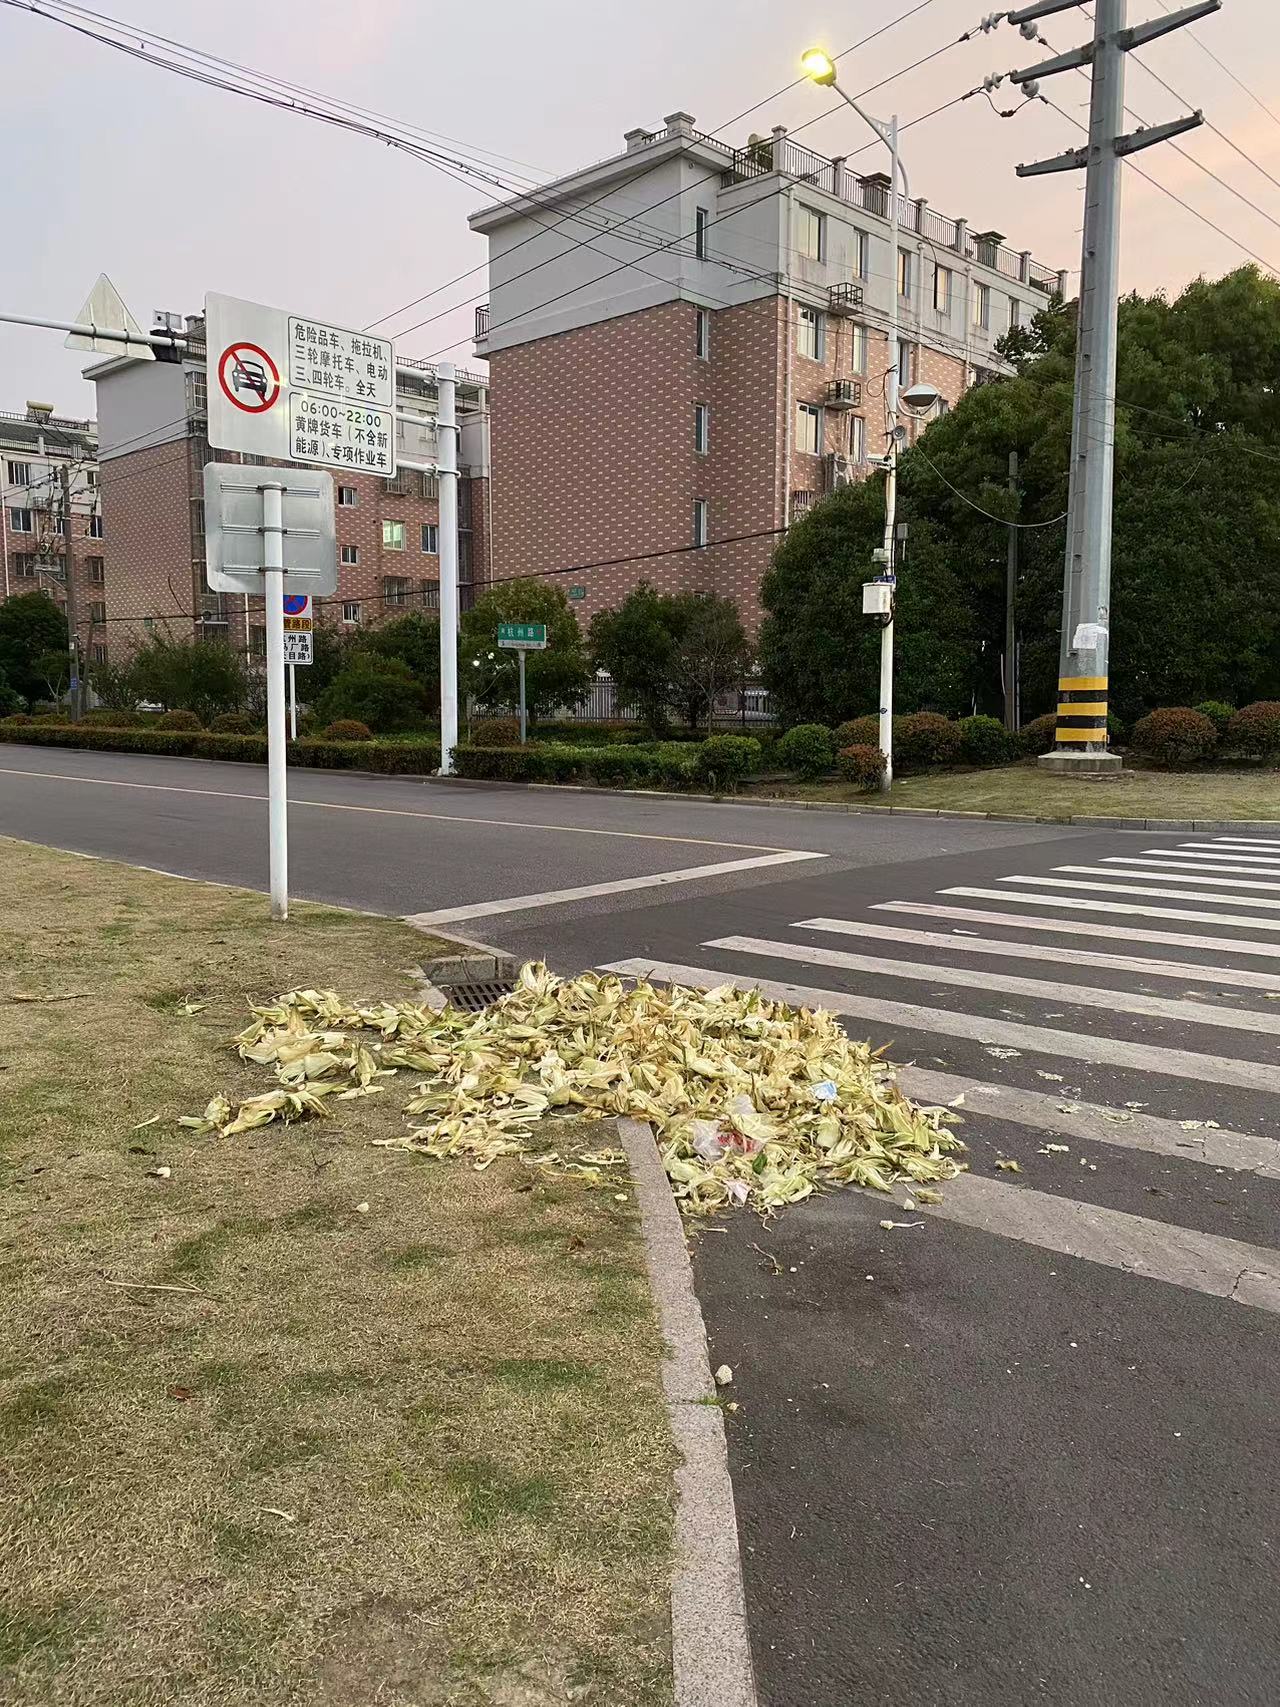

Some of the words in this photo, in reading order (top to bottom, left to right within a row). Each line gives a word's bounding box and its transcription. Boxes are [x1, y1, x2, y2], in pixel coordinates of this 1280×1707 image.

[295, 323, 387, 362] 危险品车、拖拉机、
[295, 344, 387, 380] 三轮摩托车、电动
[301, 400, 381, 428] 06:00~22:00
[295, 416, 387, 448] 黄牌货车（不含新
[295, 436, 387, 468] 能源）、专项作业车
[283, 634, 307, 643] 州路
